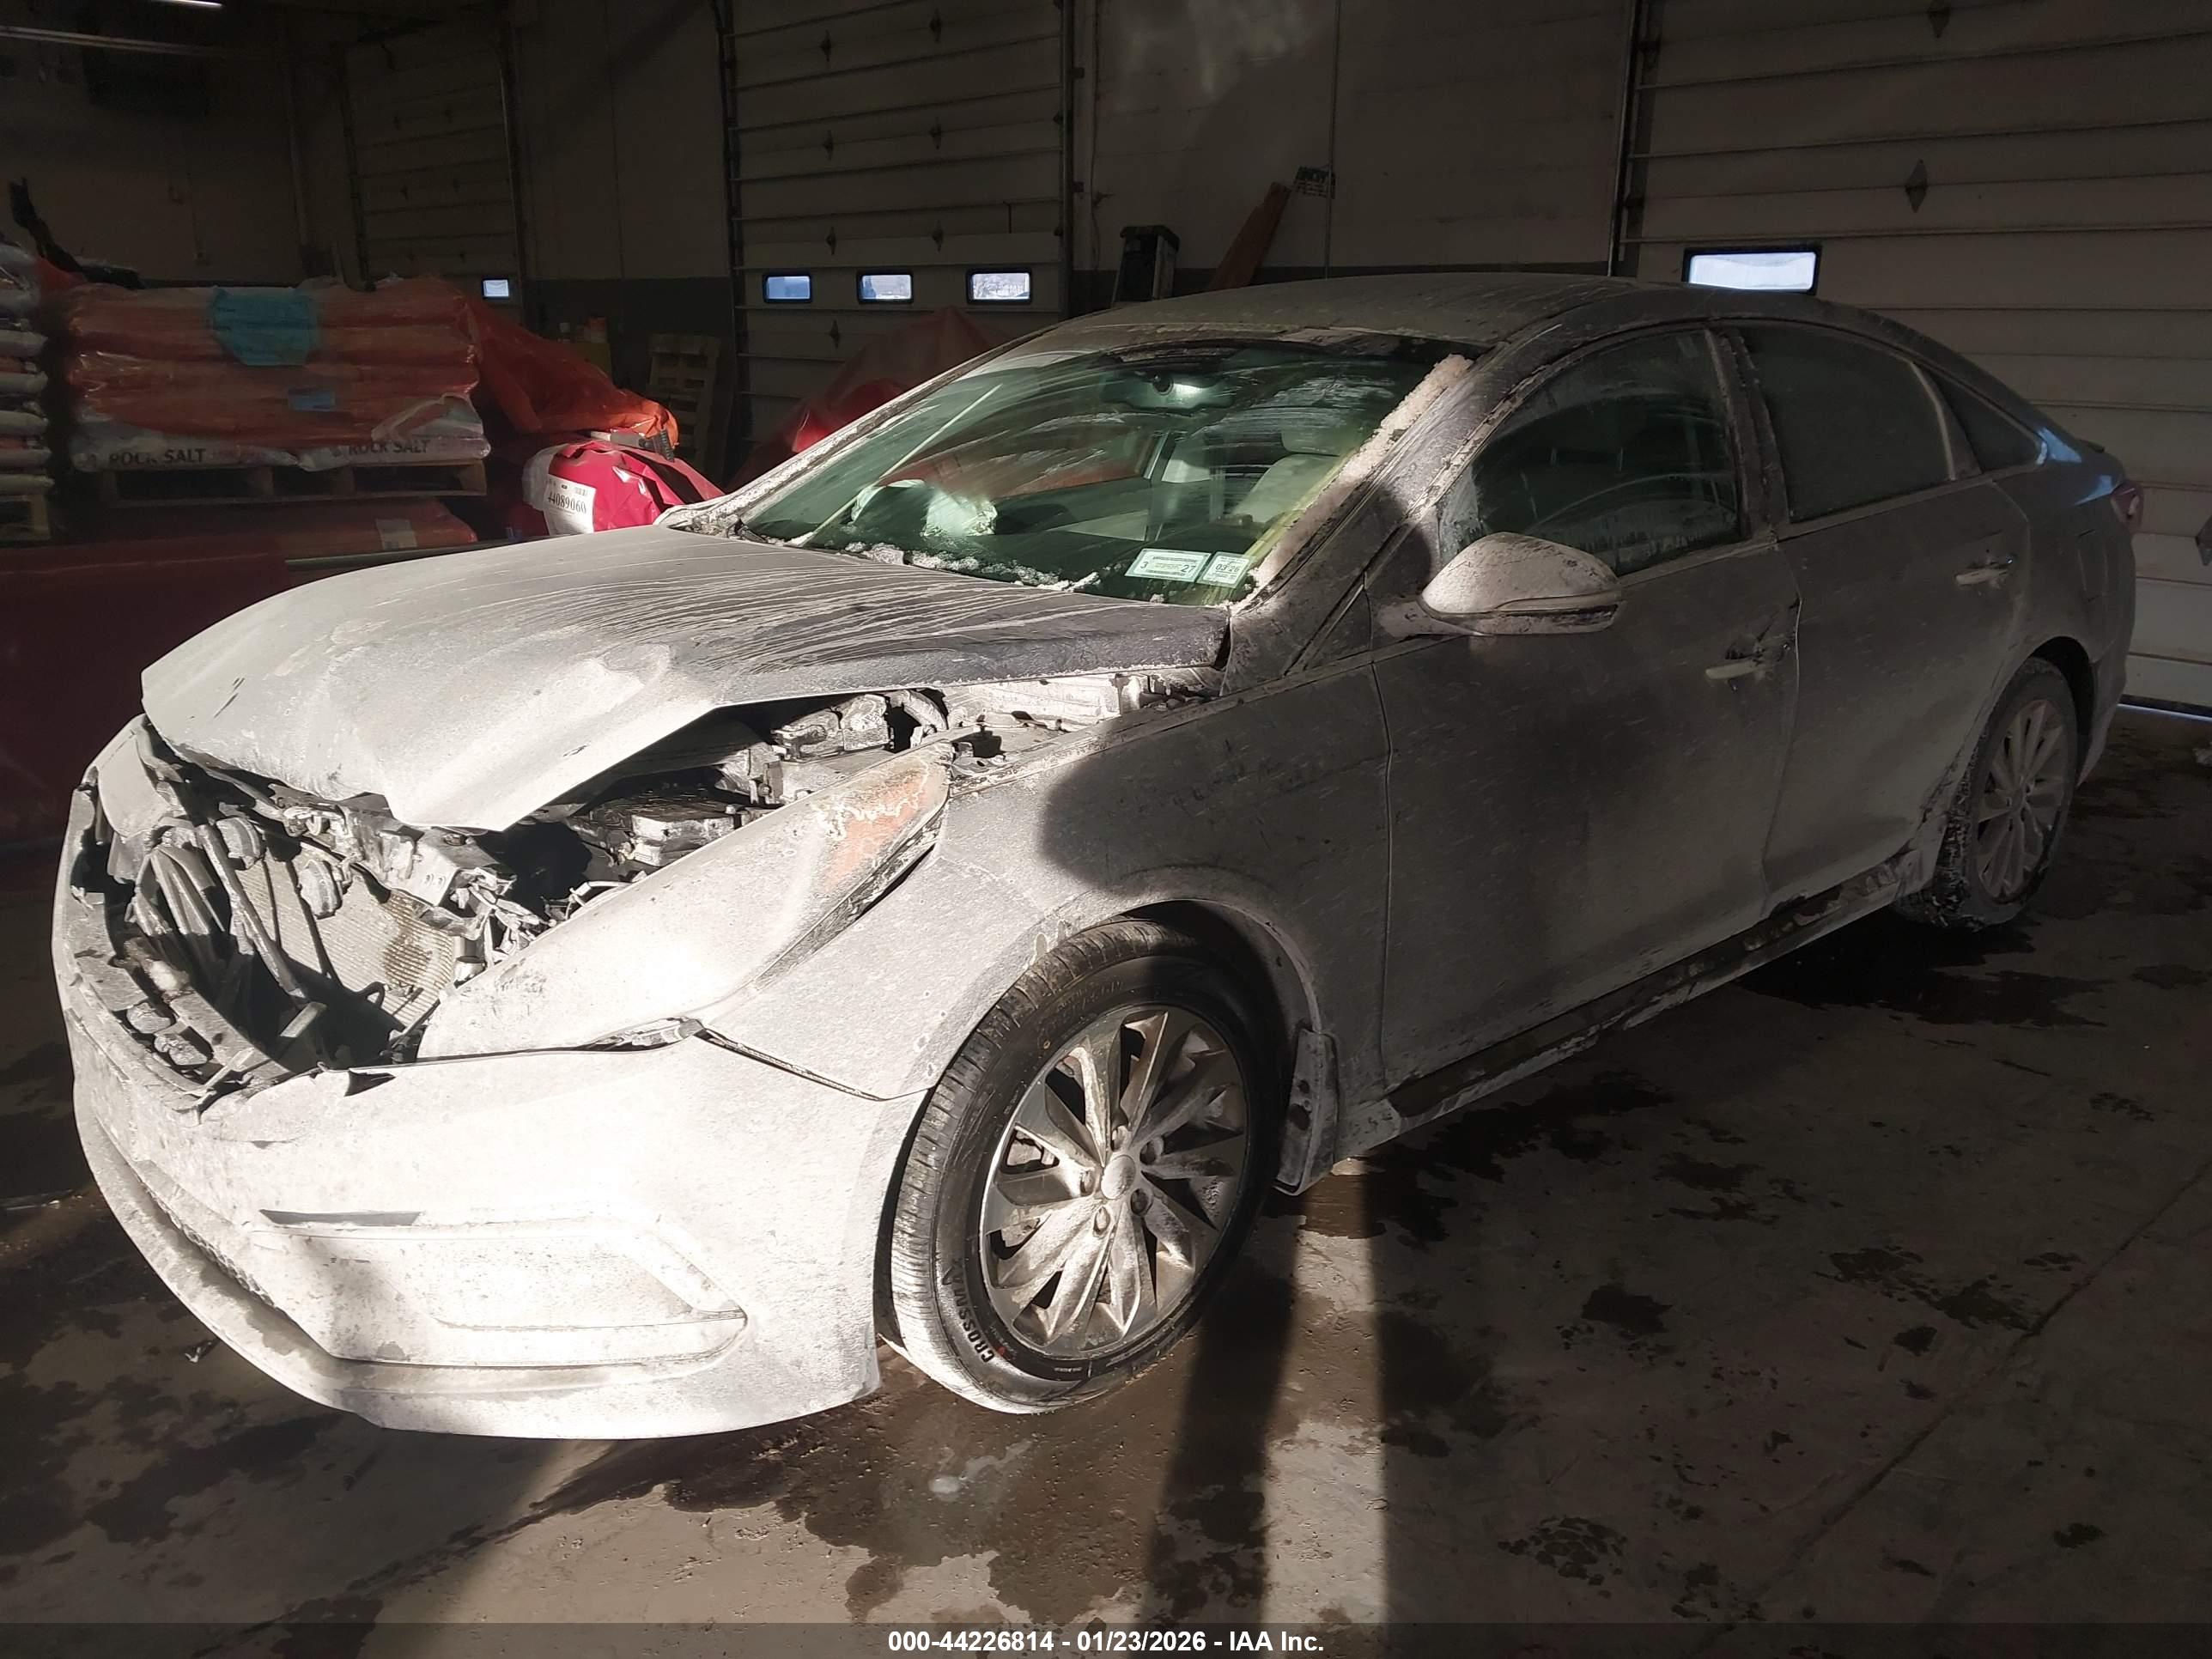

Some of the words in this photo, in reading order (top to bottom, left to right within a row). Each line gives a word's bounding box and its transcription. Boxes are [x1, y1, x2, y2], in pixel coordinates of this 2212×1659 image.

[392, 439, 431, 453] SALT
[164, 448, 207, 464] SALT
[1180, 563, 1197, 574] 27
